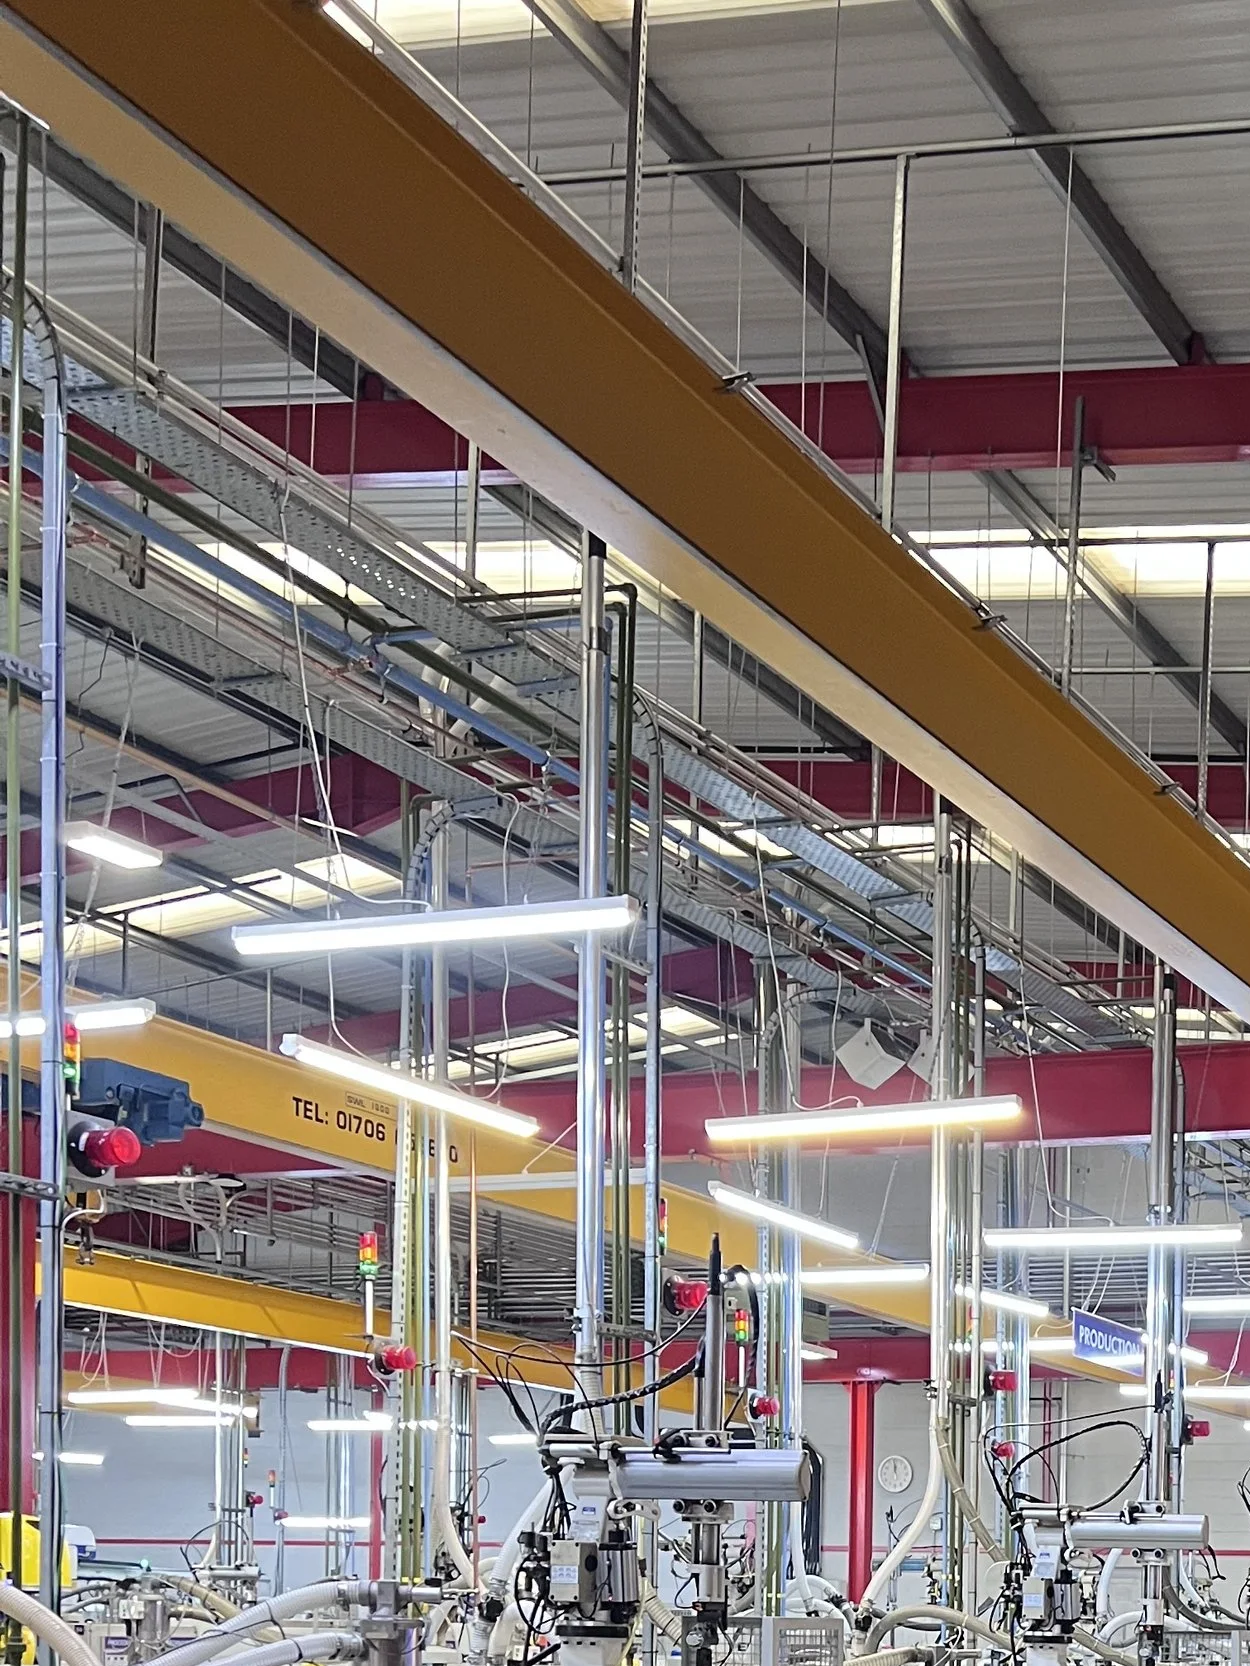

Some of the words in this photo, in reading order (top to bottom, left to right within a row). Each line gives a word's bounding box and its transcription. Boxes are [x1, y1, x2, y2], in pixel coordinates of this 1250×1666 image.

[292, 1096, 329, 1125] TEL:
[336, 1110, 386, 1142] 01706
[1079, 1324, 1140, 1356] PRODUCTION
